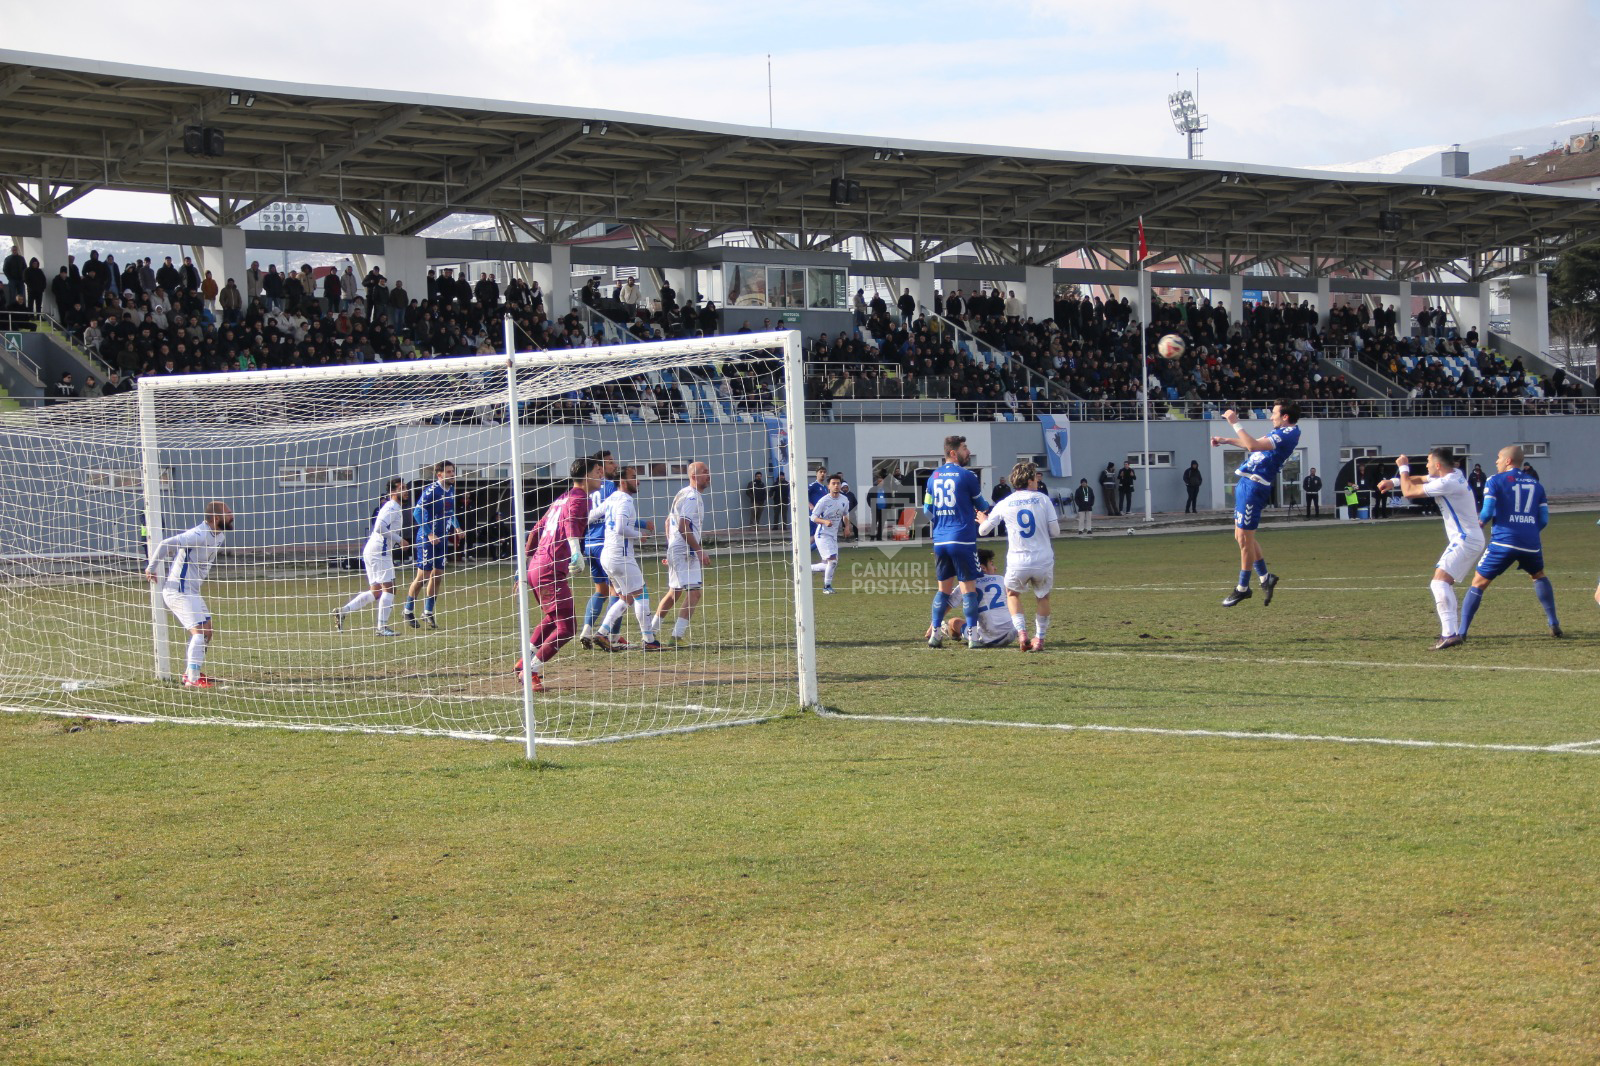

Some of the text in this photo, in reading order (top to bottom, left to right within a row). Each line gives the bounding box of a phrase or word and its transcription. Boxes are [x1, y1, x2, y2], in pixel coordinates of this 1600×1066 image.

[933, 478, 957, 508] 53
[1511, 483, 1535, 513] 17
[1016, 508, 1036, 539] 9
